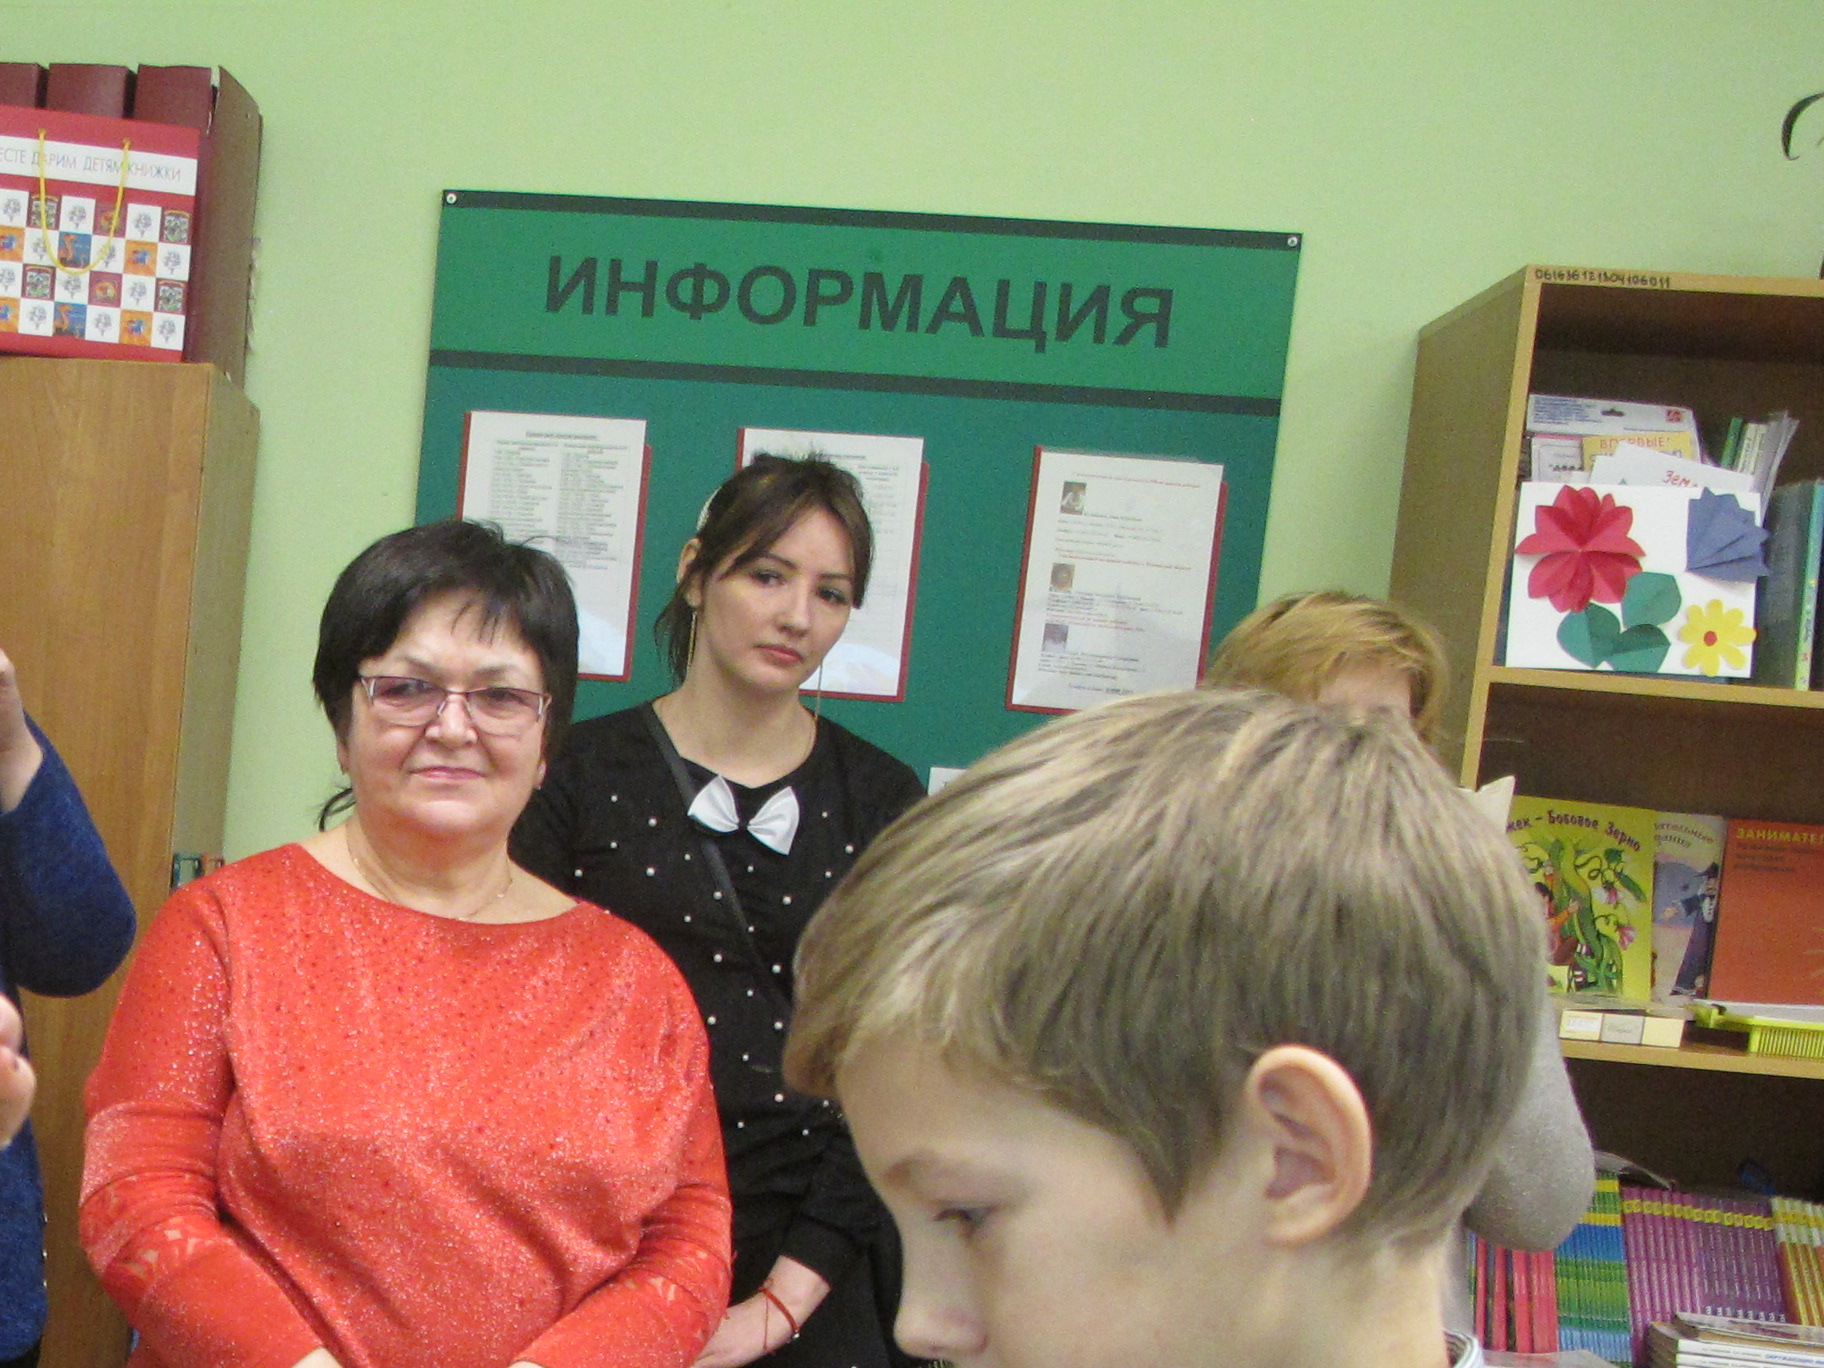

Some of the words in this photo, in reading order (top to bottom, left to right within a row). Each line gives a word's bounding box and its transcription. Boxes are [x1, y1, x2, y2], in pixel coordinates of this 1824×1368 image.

[126, 161, 181, 181] КНИЖКИ
[544, 254, 1174, 354] ИНФОРМАЦИЯ
[1662, 470, 1698, 488] Зем
[1547, 809, 1599, 829] Бобовое
[1604, 820, 1641, 852] Зерно
